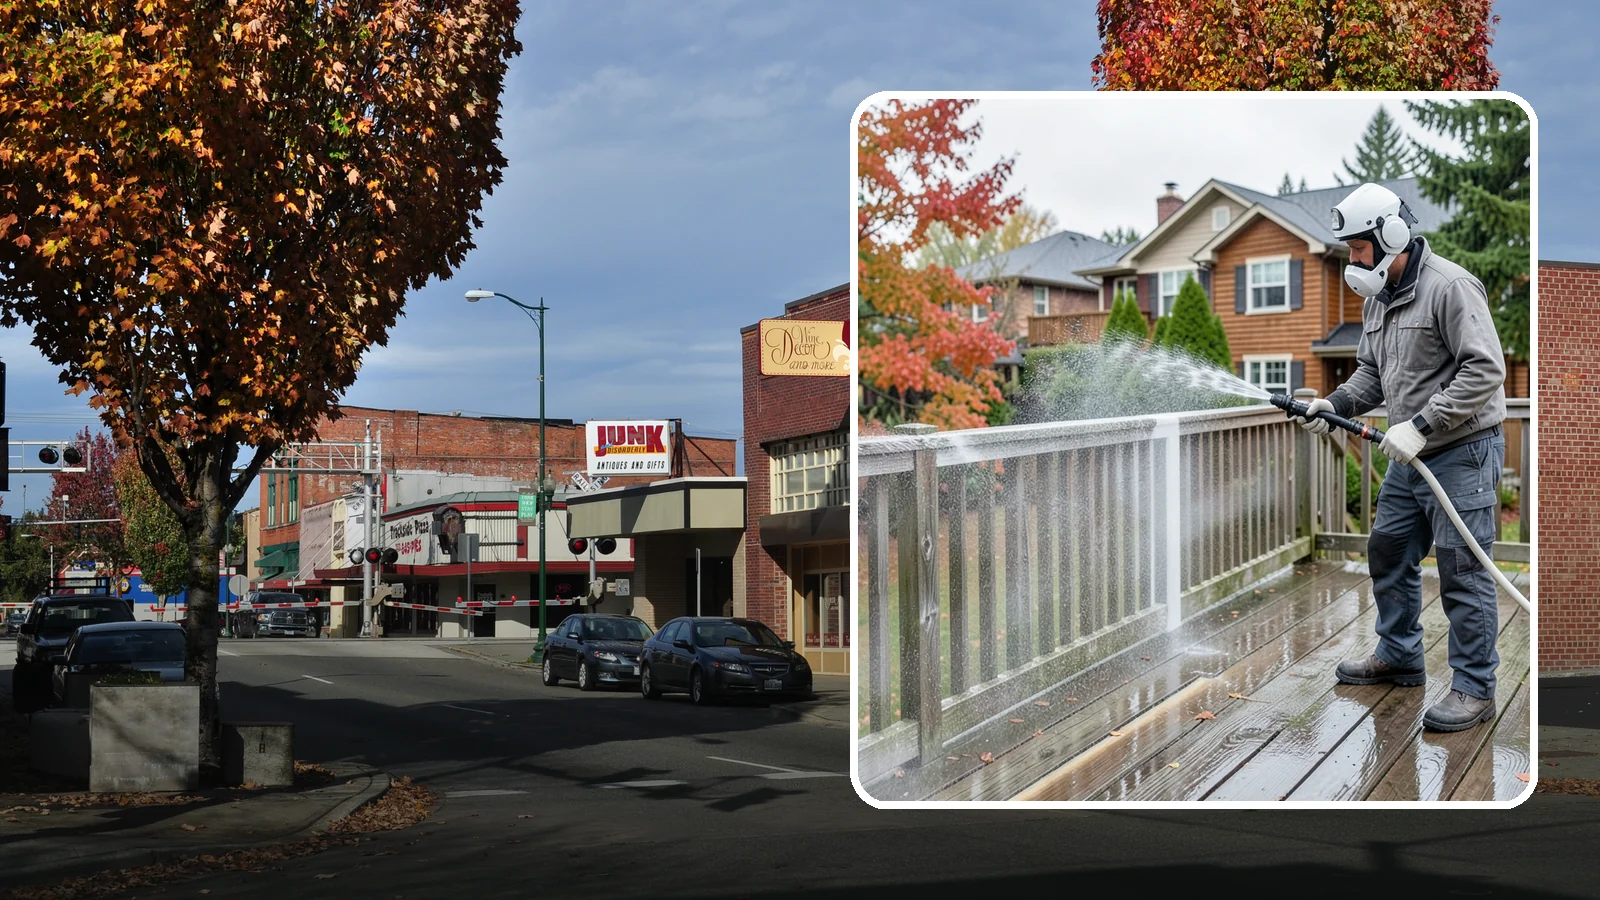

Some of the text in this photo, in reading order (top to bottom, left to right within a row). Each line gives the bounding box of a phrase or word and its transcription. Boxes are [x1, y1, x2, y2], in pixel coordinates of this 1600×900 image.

[595, 425, 664, 457] JUNK
[608, 446, 645, 454] DISORDERLY
[597, 461, 665, 470] ANTIQUES AND GIFTS
[414, 519, 429, 535] Pizza
